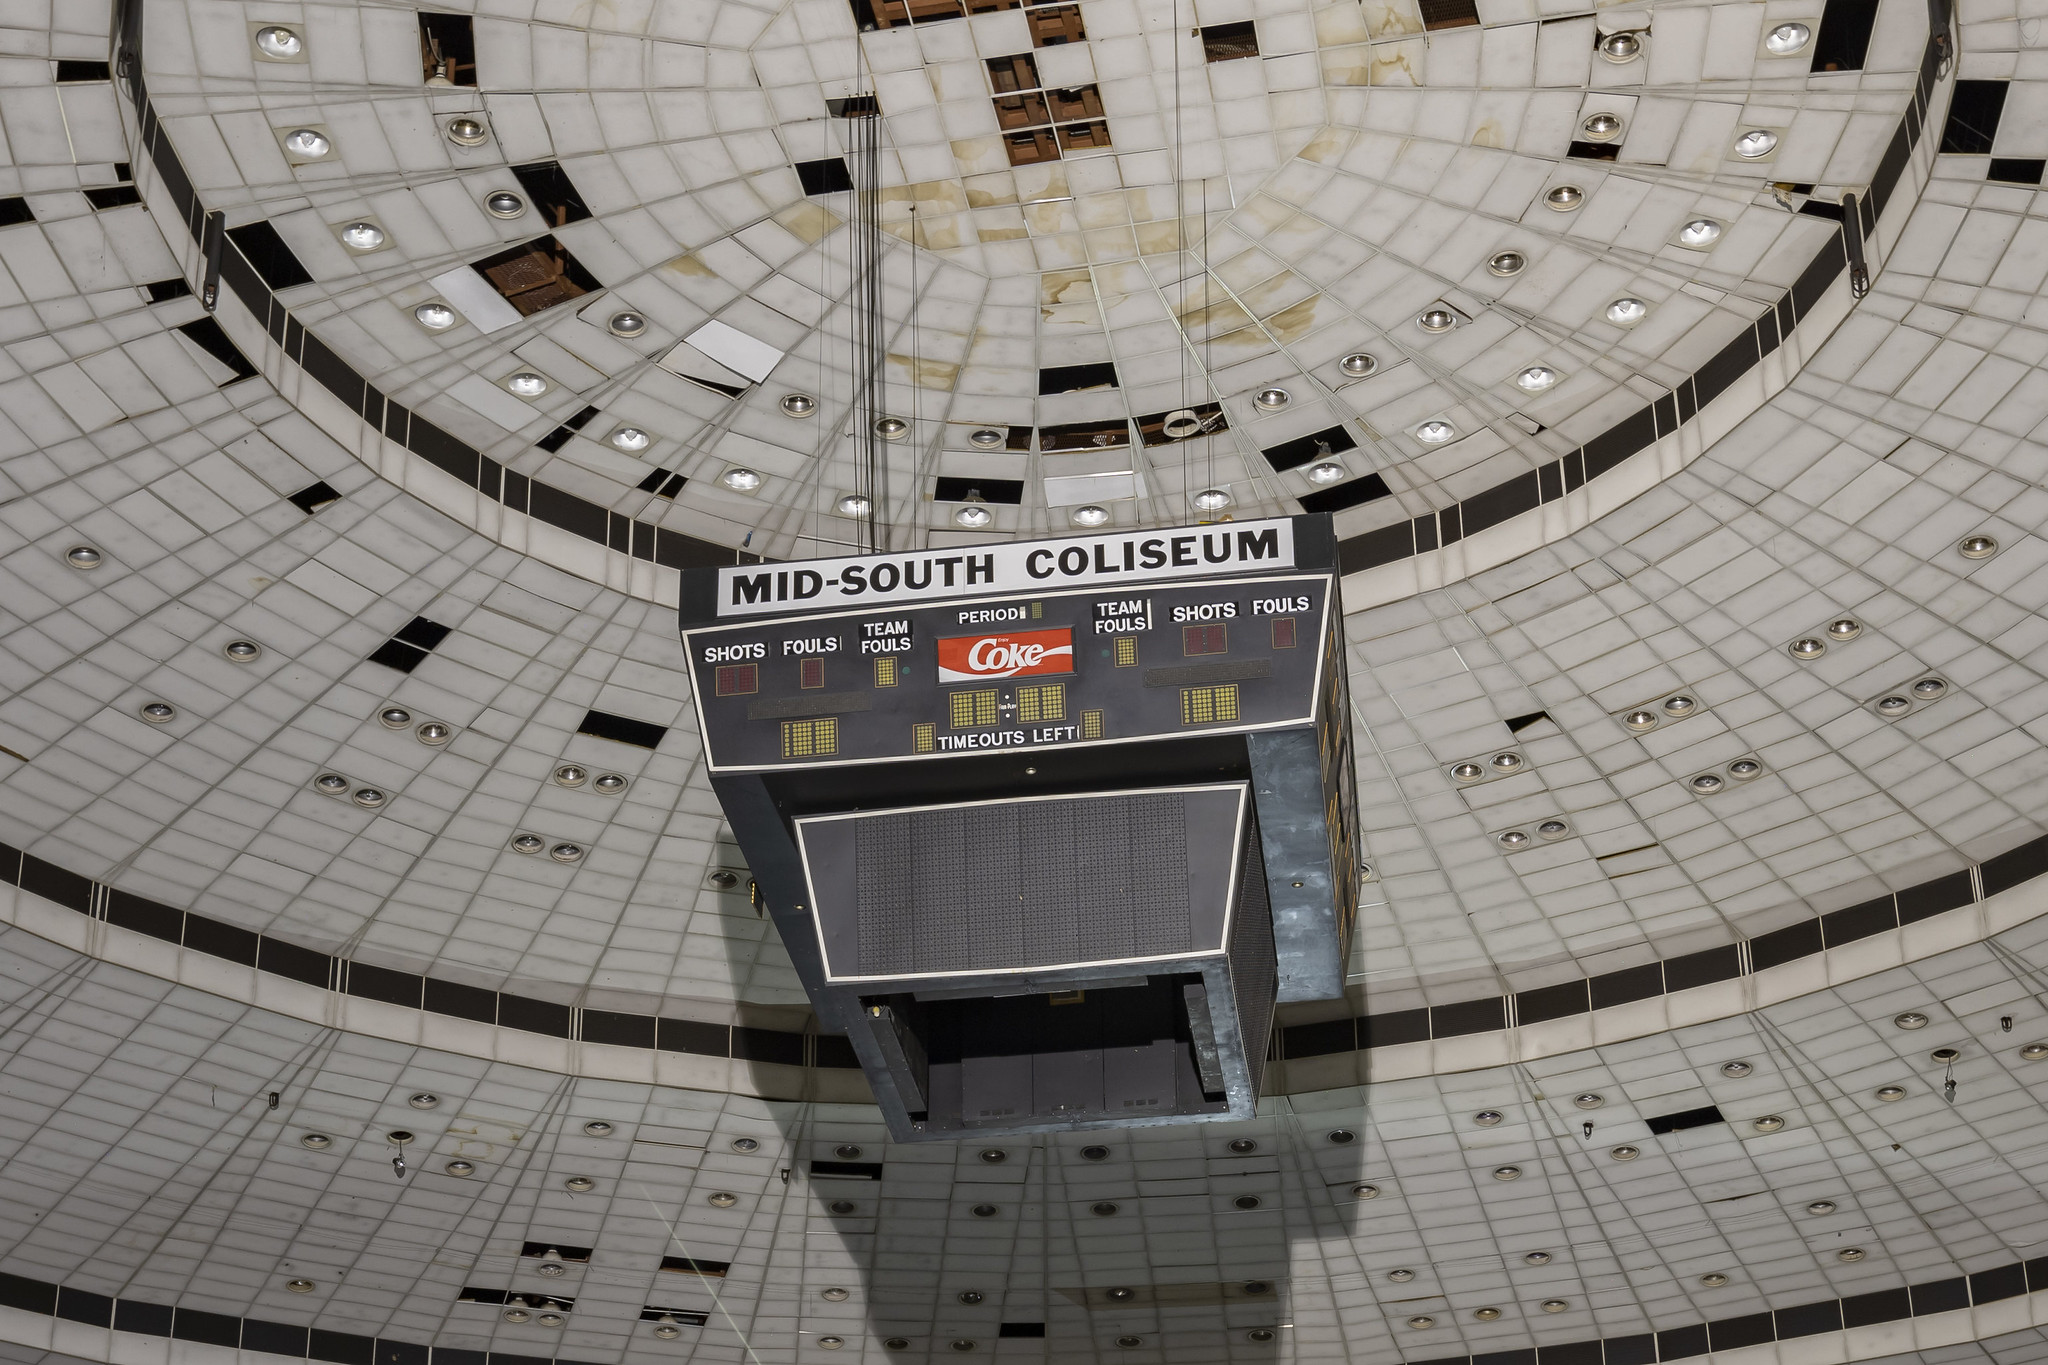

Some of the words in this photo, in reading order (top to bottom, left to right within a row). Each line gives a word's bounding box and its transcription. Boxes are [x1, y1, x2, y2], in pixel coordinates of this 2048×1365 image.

[732, 553, 994, 606] MID-SOUTH
[1025, 528, 1280, 579] COLISEUM
[1096, 600, 1143, 617] TEAM
[1173, 602, 1236, 622] SHOTS
[1252, 596, 1309, 615] FOULS
[958, 608, 1018, 624] PERIOD
[863, 620, 909, 637] TEAM
[1095, 617, 1146, 634] FOULS
[704, 643, 766, 662] SHOTS
[783, 637, 837, 655] FOULS
[861, 637, 911, 654] FOULS
[968, 638, 1044, 671] Coke
[938, 731, 1024, 750] TIMEOUTS
[1033, 726, 1075, 742] LEFT
